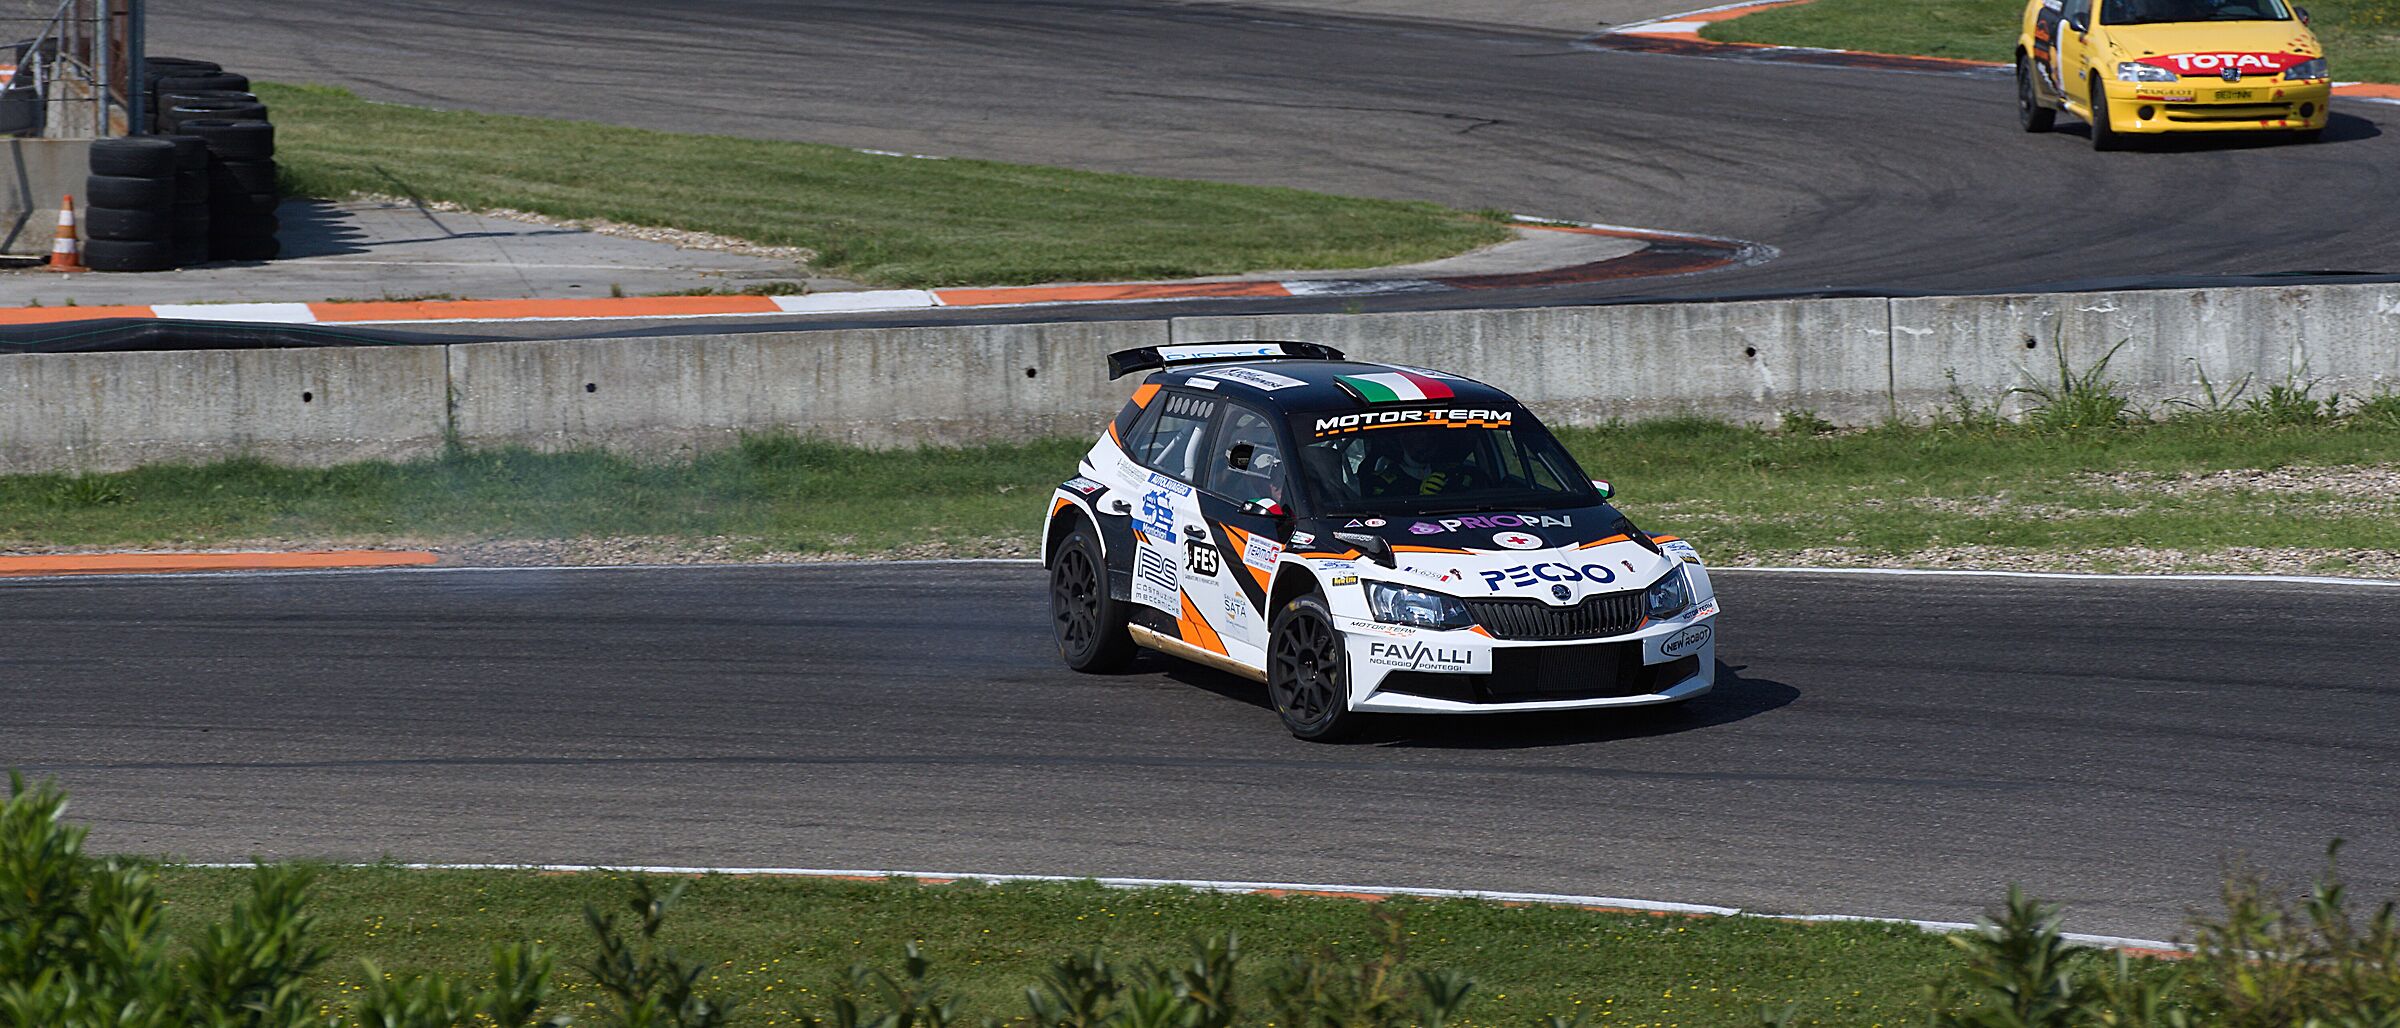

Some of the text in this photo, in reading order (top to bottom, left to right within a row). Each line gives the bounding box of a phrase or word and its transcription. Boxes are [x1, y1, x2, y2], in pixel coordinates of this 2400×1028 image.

[2168, 54, 2280, 70] TOTAL
[2136, 88, 2192, 96] PEUGEOT
[1193, 546, 1217, 574] FES
[1224, 599, 1246, 618] SATA
[1666, 629, 1709, 653] NEW ROBOT
[1370, 641, 1471, 667] FAVALLI
[1370, 658, 1462, 671] NOLEGGIO PONTEGGI
